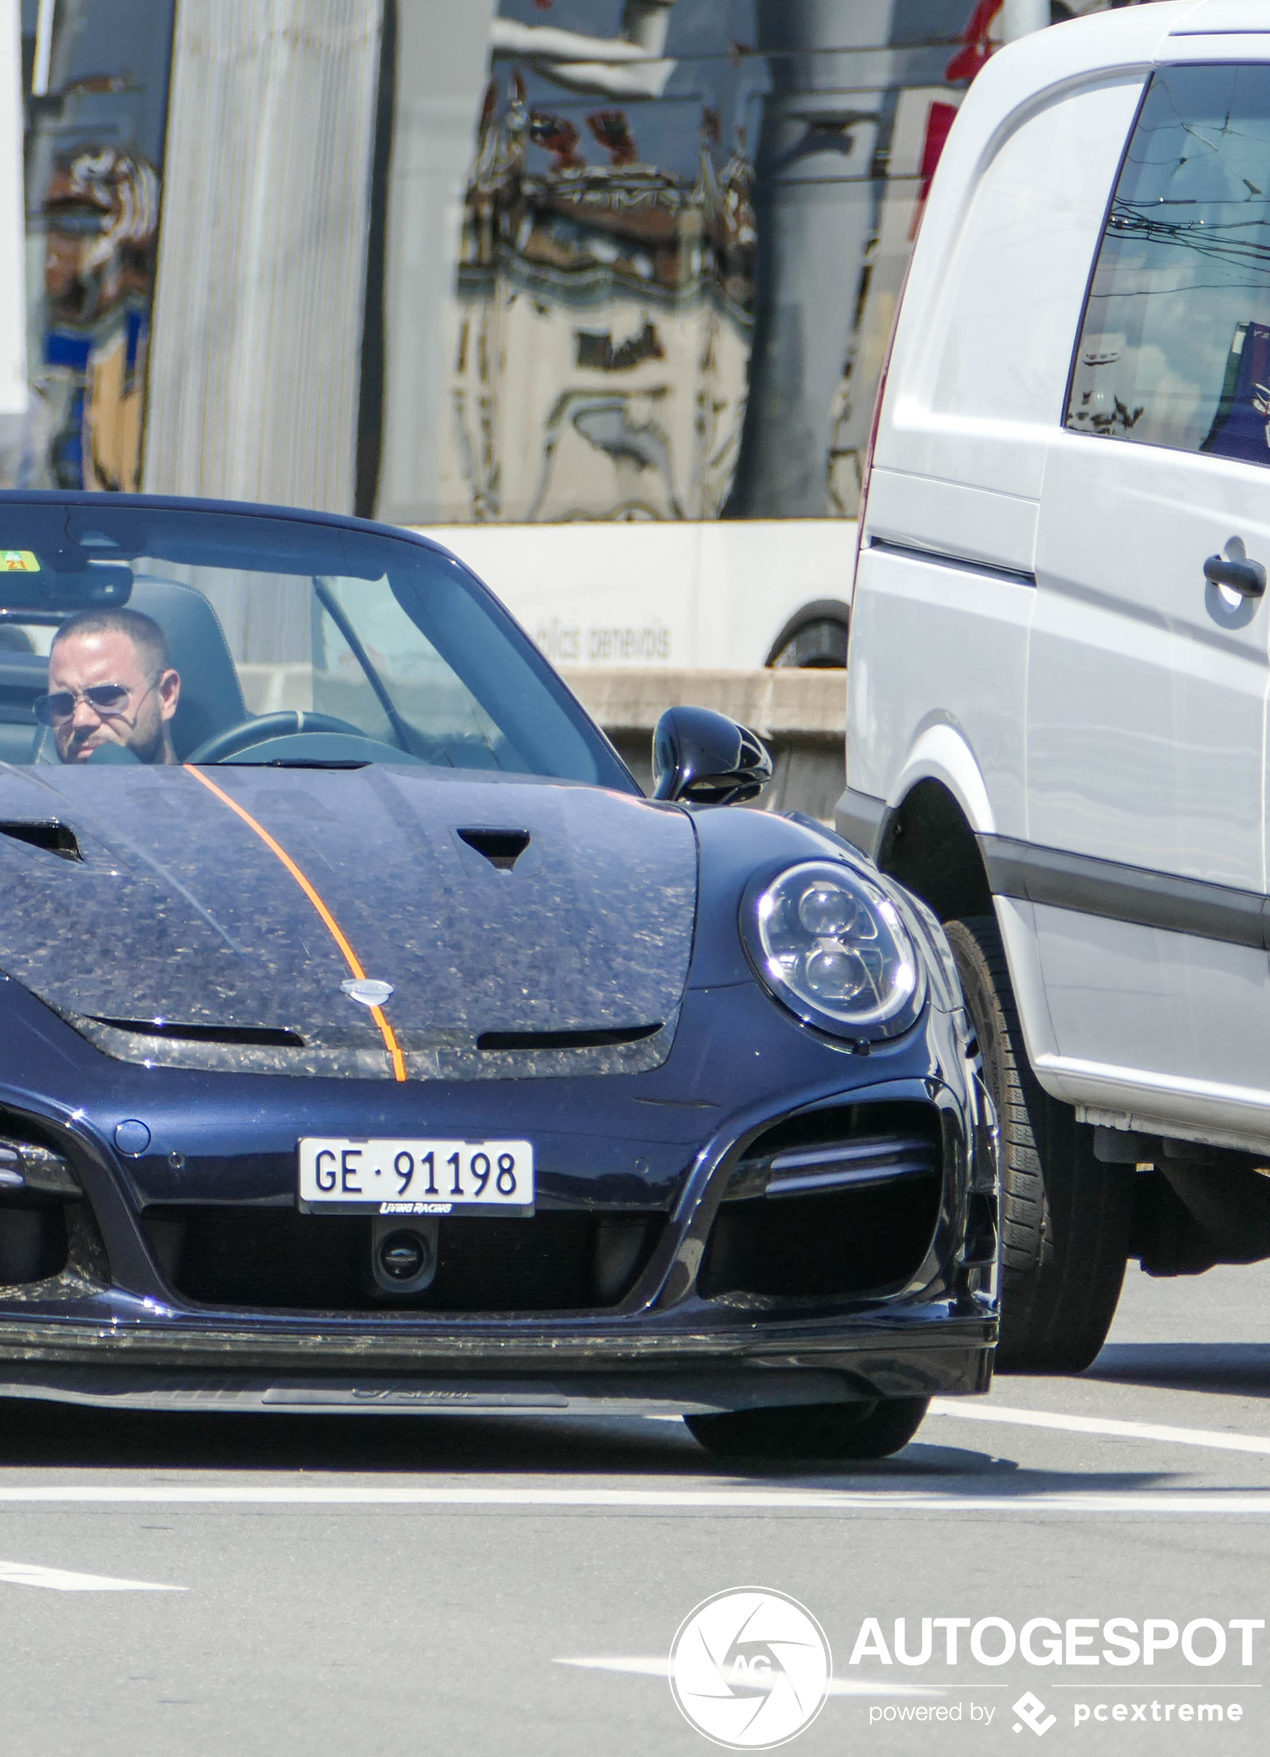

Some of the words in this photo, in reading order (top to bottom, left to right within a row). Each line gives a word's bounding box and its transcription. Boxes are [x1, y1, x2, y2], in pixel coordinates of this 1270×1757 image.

[315, 1149, 363, 1194] GE
[393, 1151, 518, 1197] 91198
[413, 1202, 453, 1214] RACING
